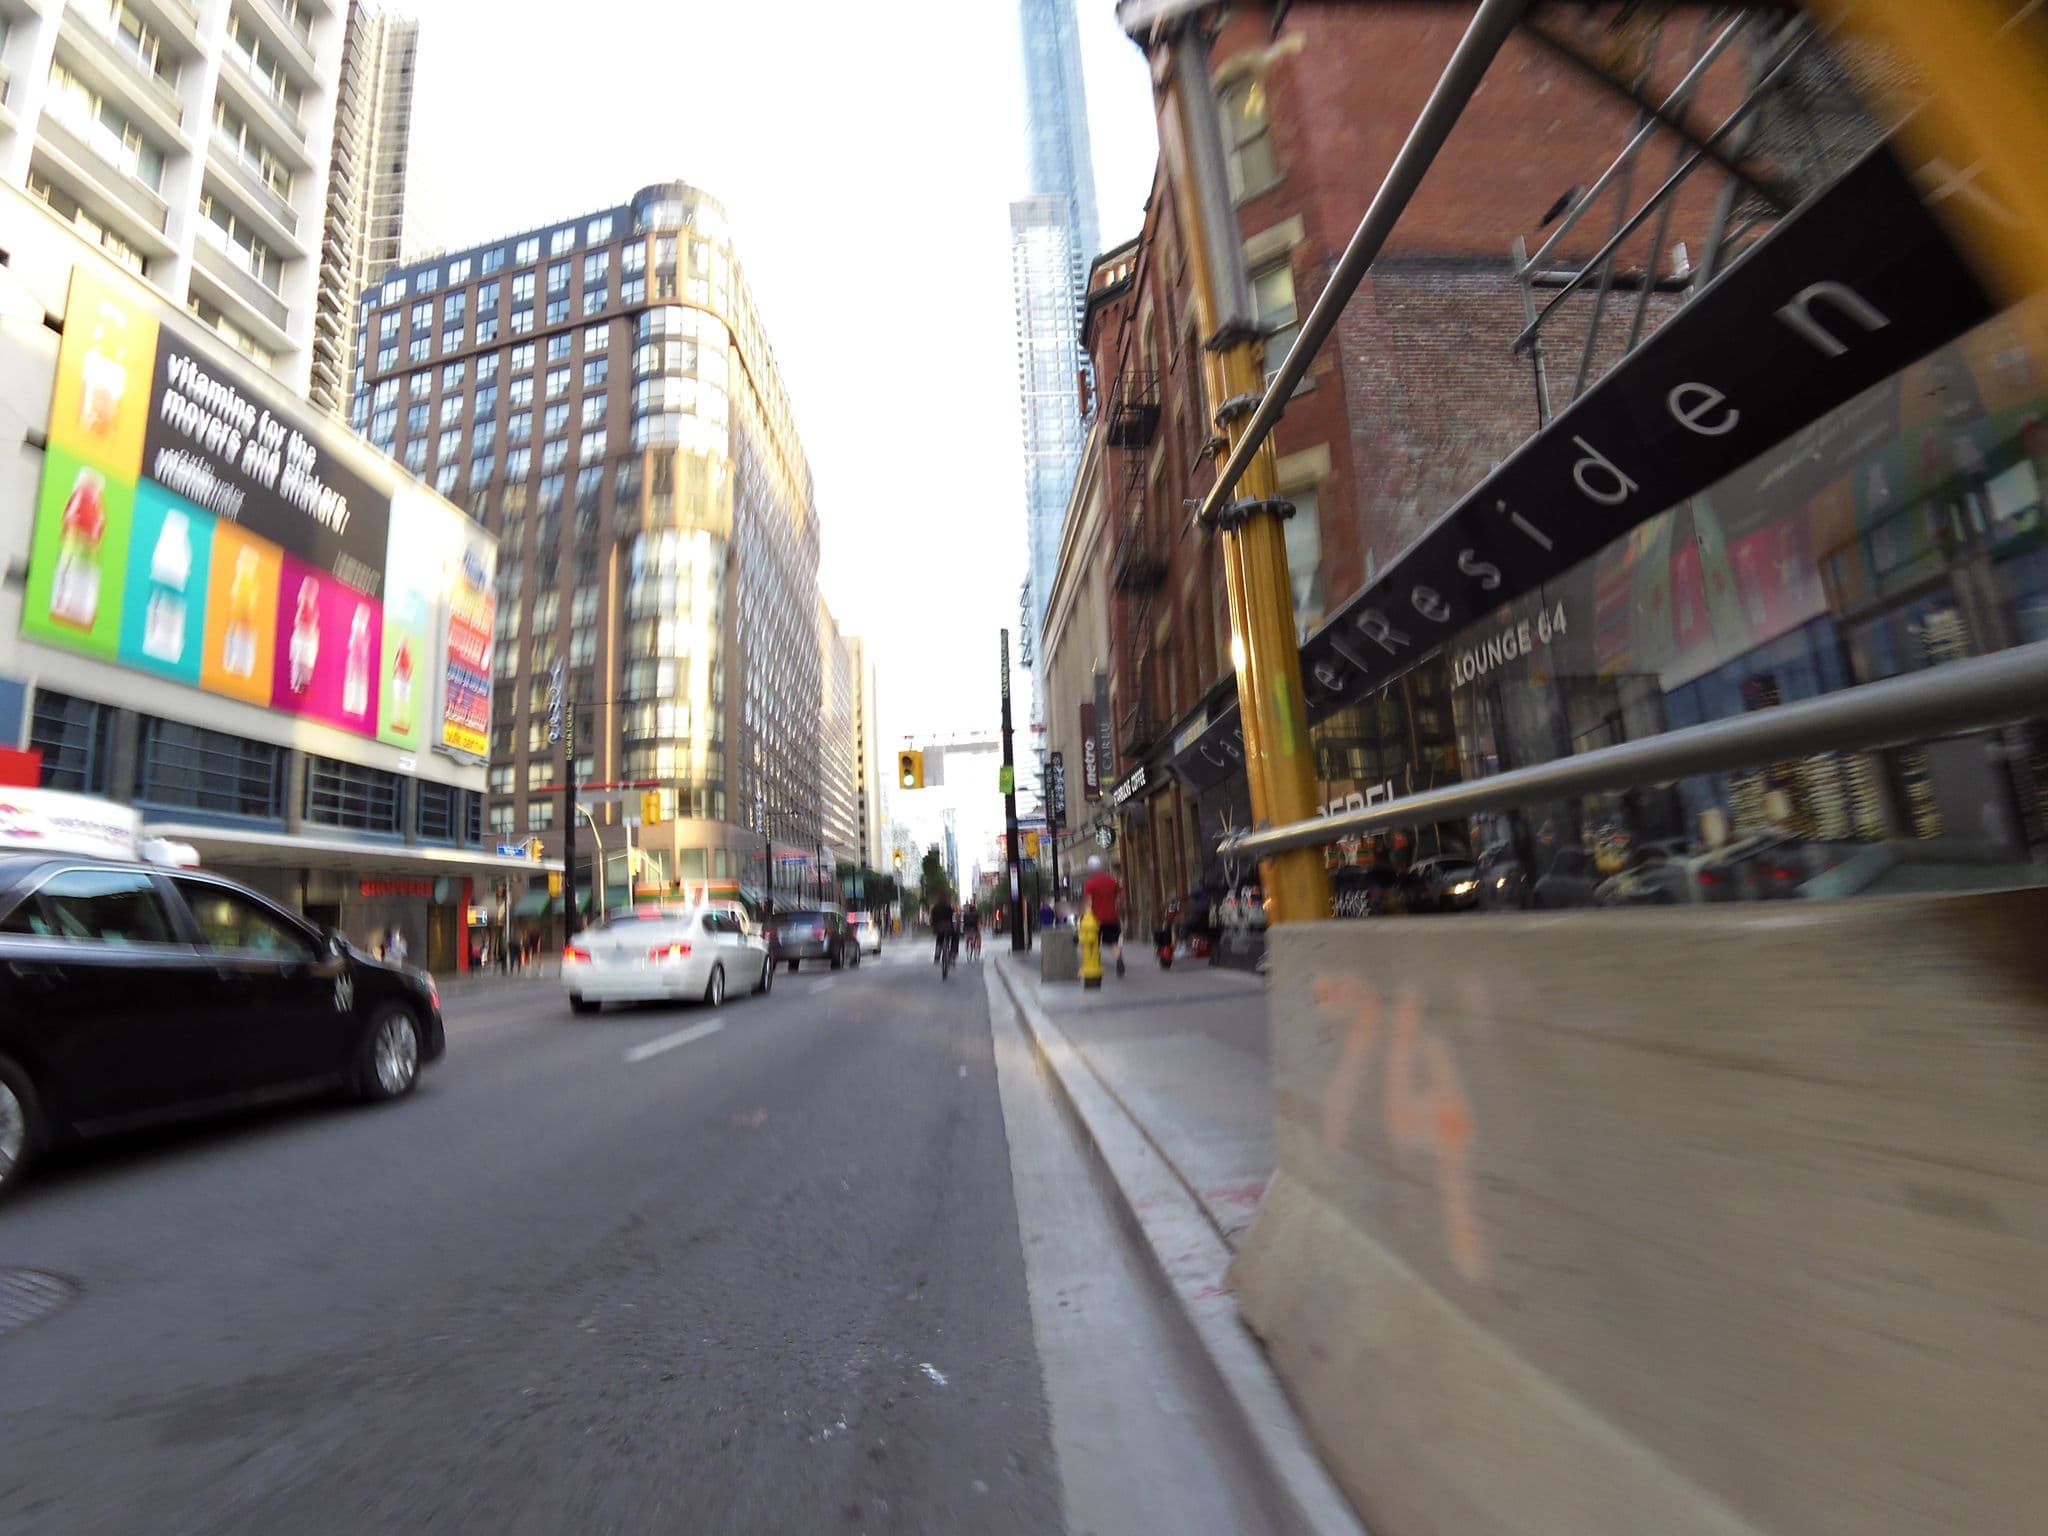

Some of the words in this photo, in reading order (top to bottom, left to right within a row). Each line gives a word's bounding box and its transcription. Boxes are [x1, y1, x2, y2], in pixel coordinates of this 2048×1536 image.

[160, 388, 242, 465] movers
[241, 439, 281, 491] and
[168, 353, 257, 437] vitamins
[257, 410, 287, 452] for
[287, 430, 317, 476] the
[1304, 279, 1892, 708] elResiden
[1454, 618, 1533, 688] LOUNGE
[1084, 737, 1098, 787] metro
[1101, 722, 1112, 771] CARLU
